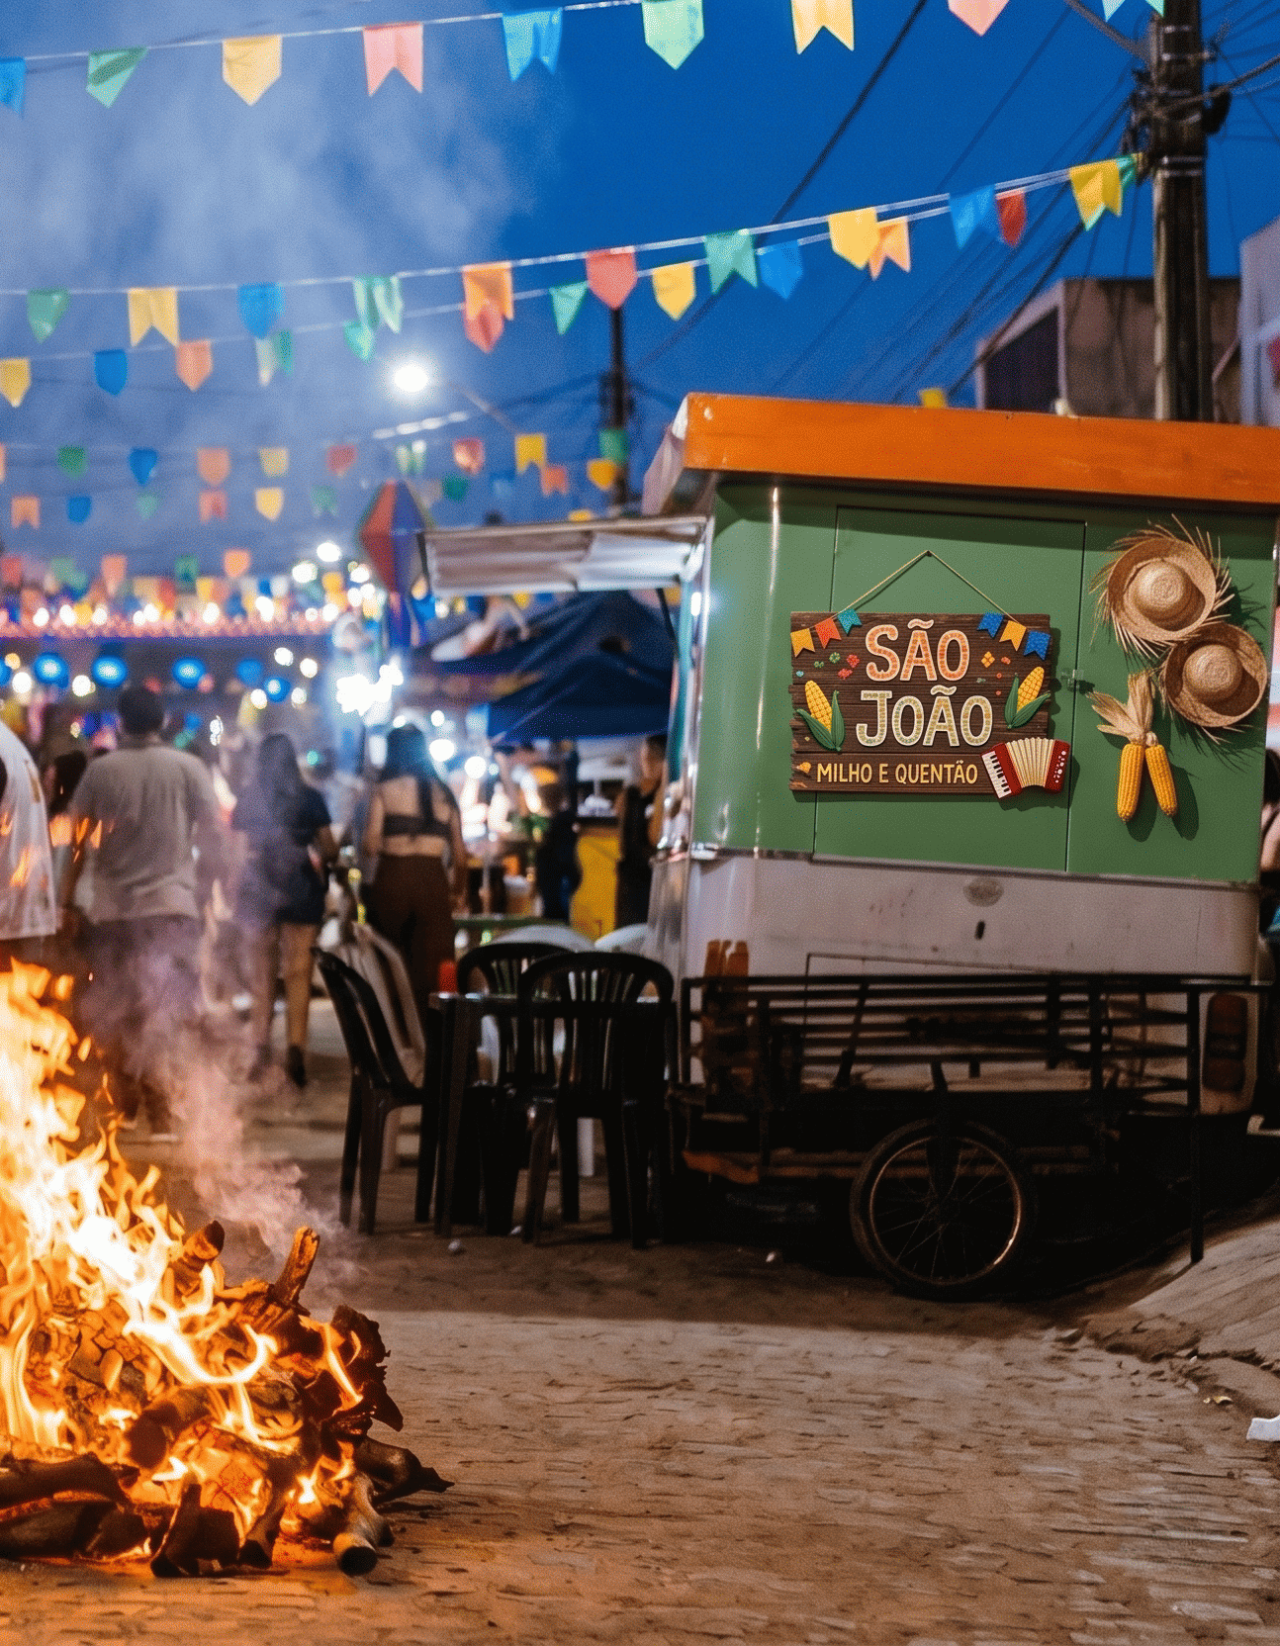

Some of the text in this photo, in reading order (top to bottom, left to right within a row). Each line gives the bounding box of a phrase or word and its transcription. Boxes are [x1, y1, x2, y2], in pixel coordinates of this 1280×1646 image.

[865, 618, 970, 682] SÃO
[856, 684, 993, 747] JOÃO
[816, 759, 979, 785] MILHO E QUENTÃO
